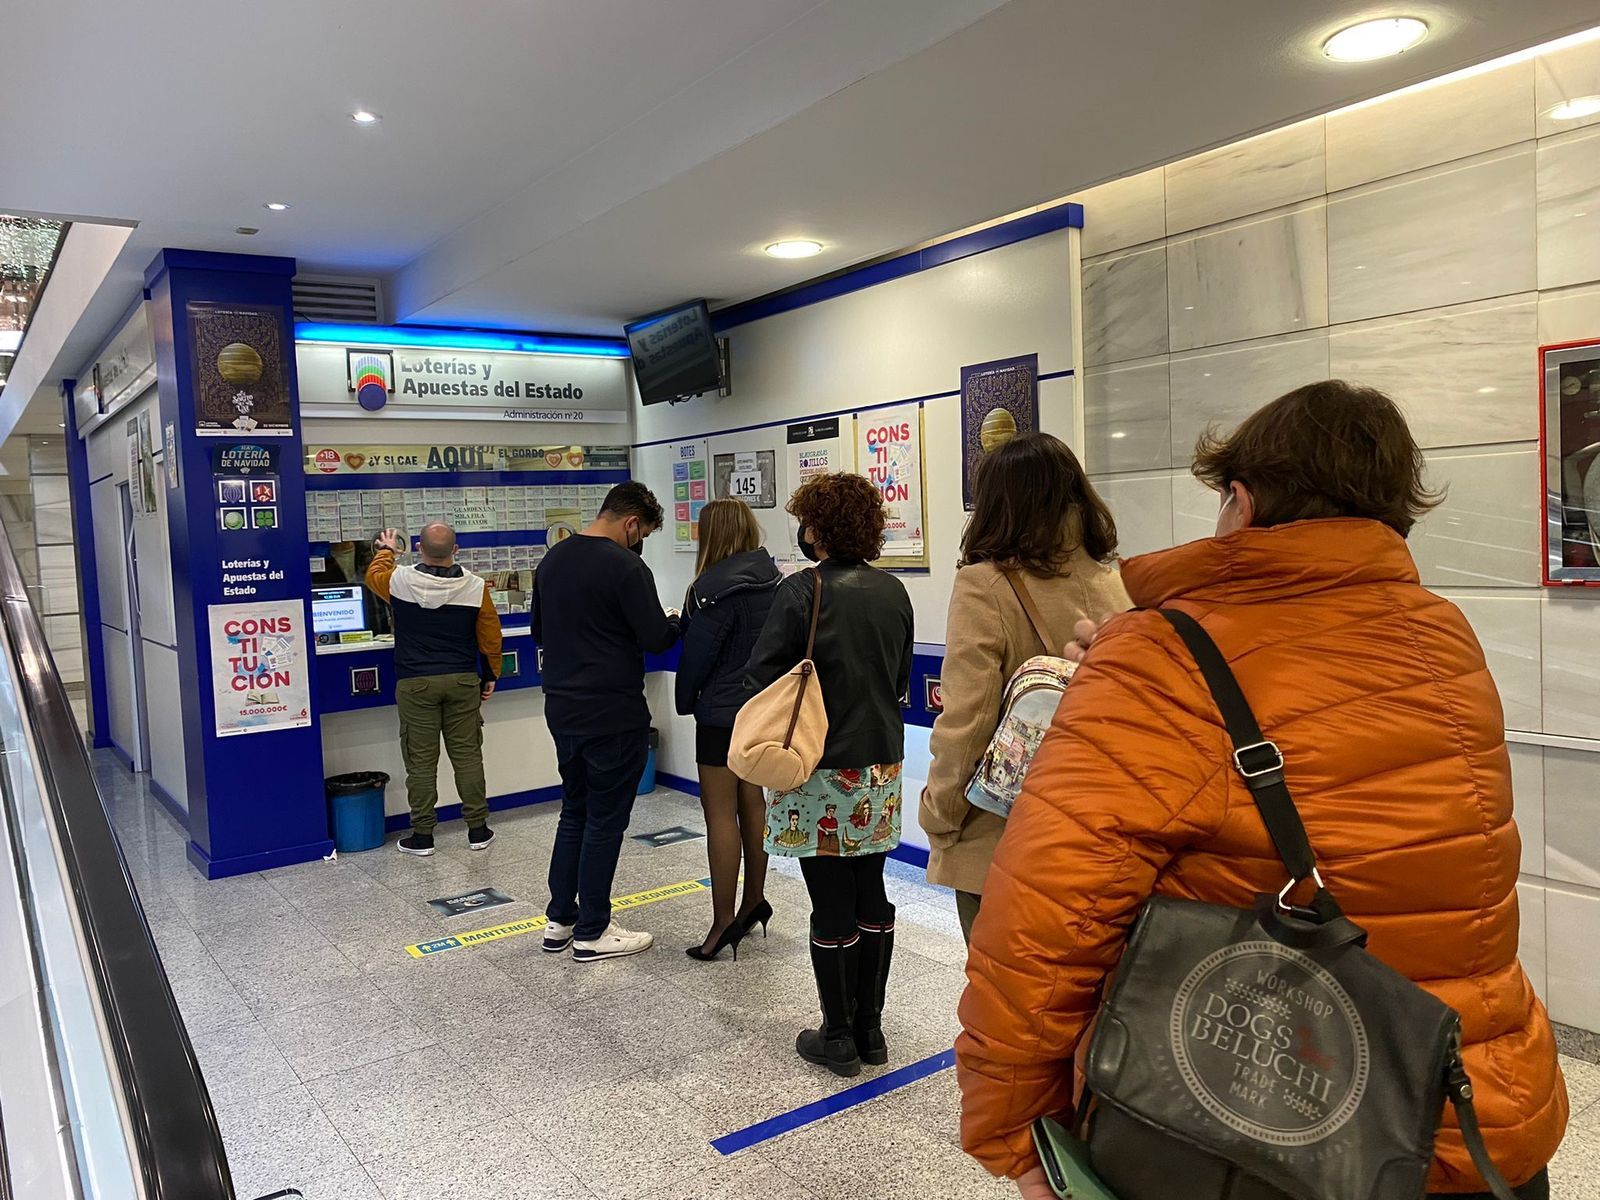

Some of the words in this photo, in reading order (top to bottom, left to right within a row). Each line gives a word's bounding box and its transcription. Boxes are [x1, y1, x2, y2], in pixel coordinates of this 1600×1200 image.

[401, 357, 477, 376] Loterías
[482, 363, 492, 380] y
[402, 378, 489, 398] Apuestas
[494, 380, 520, 397] del
[525, 383, 583, 399] Estado
[504, 409, 563, 420] Administración
[866, 423, 910, 445] CONS
[222, 448, 270, 459] LOTERÍA
[320, 450, 336, 460] +18
[368, 455, 381, 467] ¿Y
[384, 455, 394, 466] SI
[397, 455, 418, 466] CAE
[498, 448, 508, 458] EL
[512, 448, 545, 459] GORDO
[679, 445, 696, 458] BOTES
[875, 446, 887, 464] TI
[221, 459, 232, 467] DE
[234, 459, 270, 467] NAVIDAD
[868, 466, 887, 483] TU
[736, 477, 756, 495] 145
[879, 480, 908, 502] IÓN
[915, 527, 920, 536] 6
[222, 558, 262, 569] Loterías
[263, 560, 270, 569] y
[223, 572, 267, 584] Apuestas
[269, 570, 284, 580] del
[223, 585, 257, 596] Estado
[223, 617, 291, 637] CONS
[239, 638, 258, 654] TI
[228, 656, 258, 673] TU
[231, 668, 291, 692] CIÓN
[239, 705, 288, 716] 15.000.000€
[301, 708, 307, 717] 6
[462, 923, 536, 943] MANTENGA
[636, 883, 700, 901] SEGURIDAD
[1256, 970, 1334, 1019] WORKSHOP
[1203, 992, 1293, 1050] DOGS
[1190, 1013, 1336, 1104] BELUCHI
[1233, 1062, 1277, 1094] TRADE
[1229, 1081, 1268, 1109] MARK
